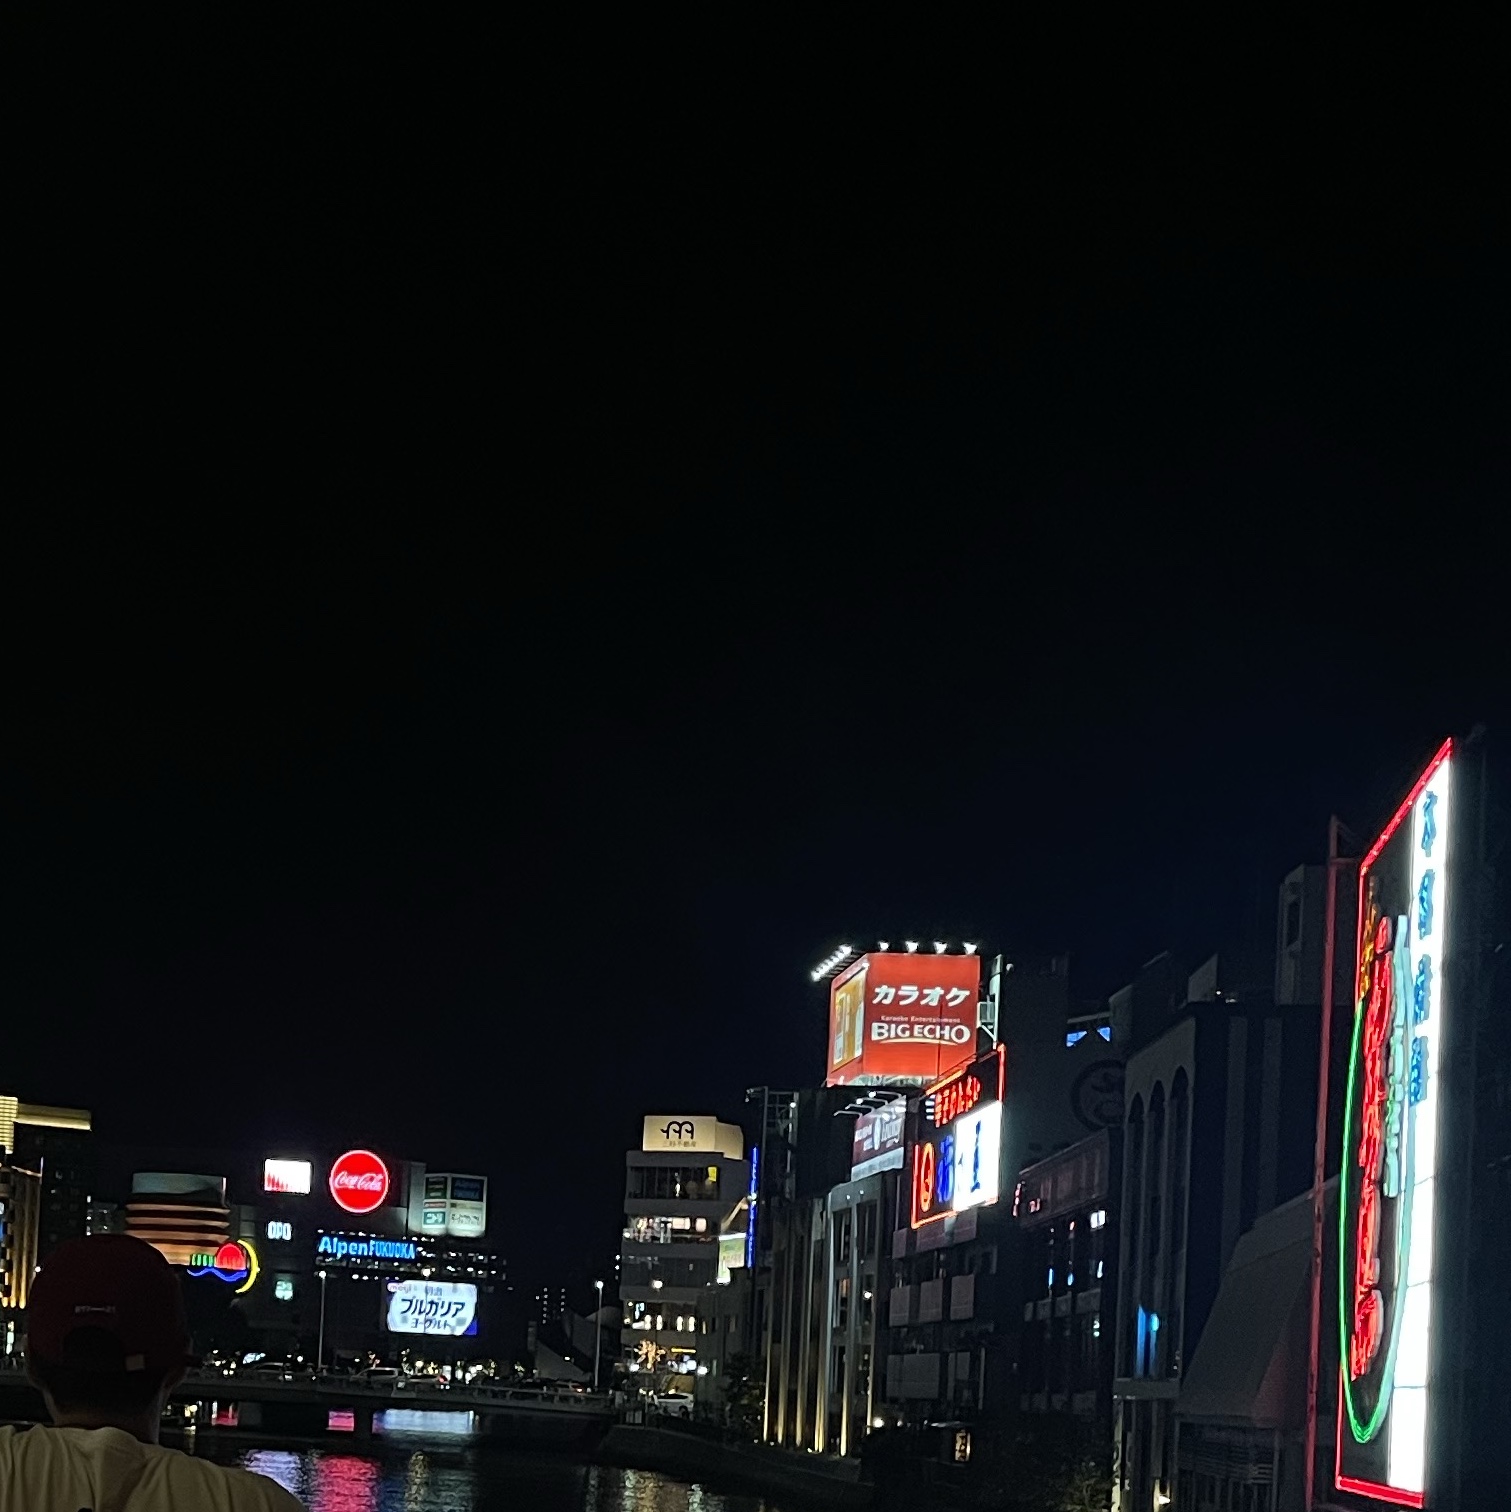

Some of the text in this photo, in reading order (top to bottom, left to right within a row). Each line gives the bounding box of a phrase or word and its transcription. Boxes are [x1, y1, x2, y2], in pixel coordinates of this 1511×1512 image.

[871, 984, 971, 1007] カラオケ
[871, 1022, 971, 1044] BIG ECHO
[318, 1236, 416, 1260] Alpen FUKUOKA
[400, 1295, 466, 1318] ブルガリア
